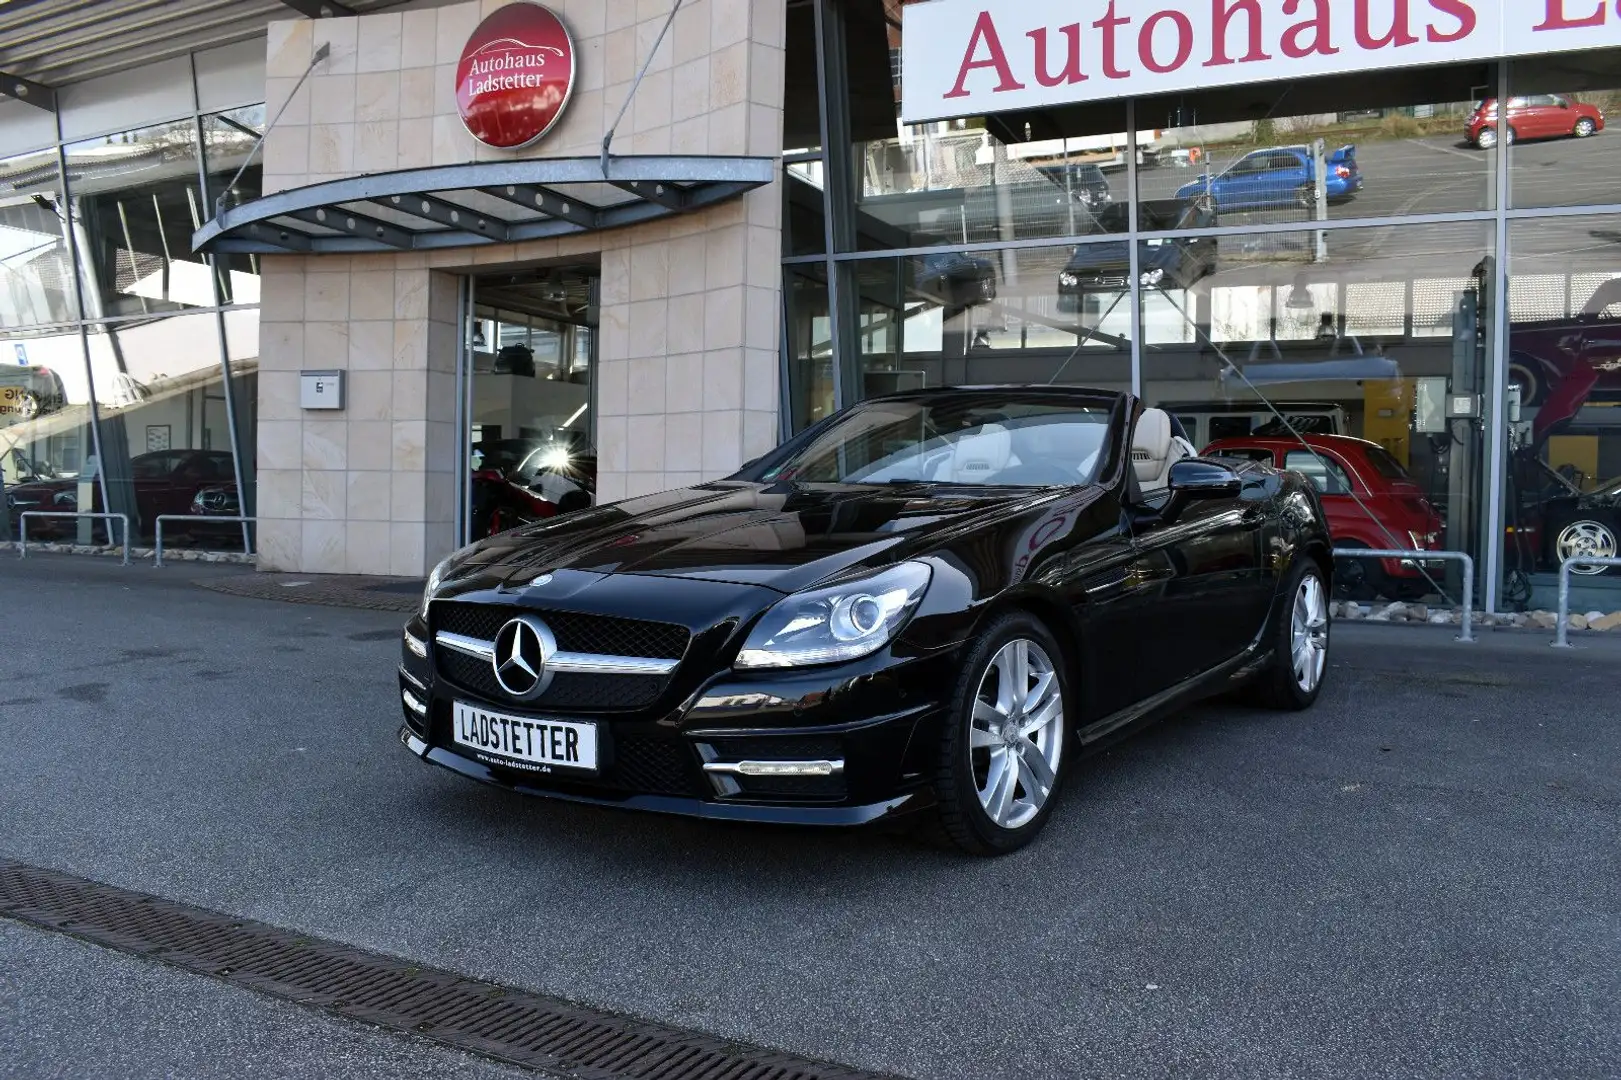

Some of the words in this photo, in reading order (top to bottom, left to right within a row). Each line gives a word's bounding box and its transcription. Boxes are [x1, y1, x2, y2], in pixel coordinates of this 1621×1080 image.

[468, 52, 545, 76] Autohaus
[942, 0, 1477, 99] Autohaus
[468, 72, 544, 97] Ladstetter
[461, 709, 578, 762] LADSTETTER
